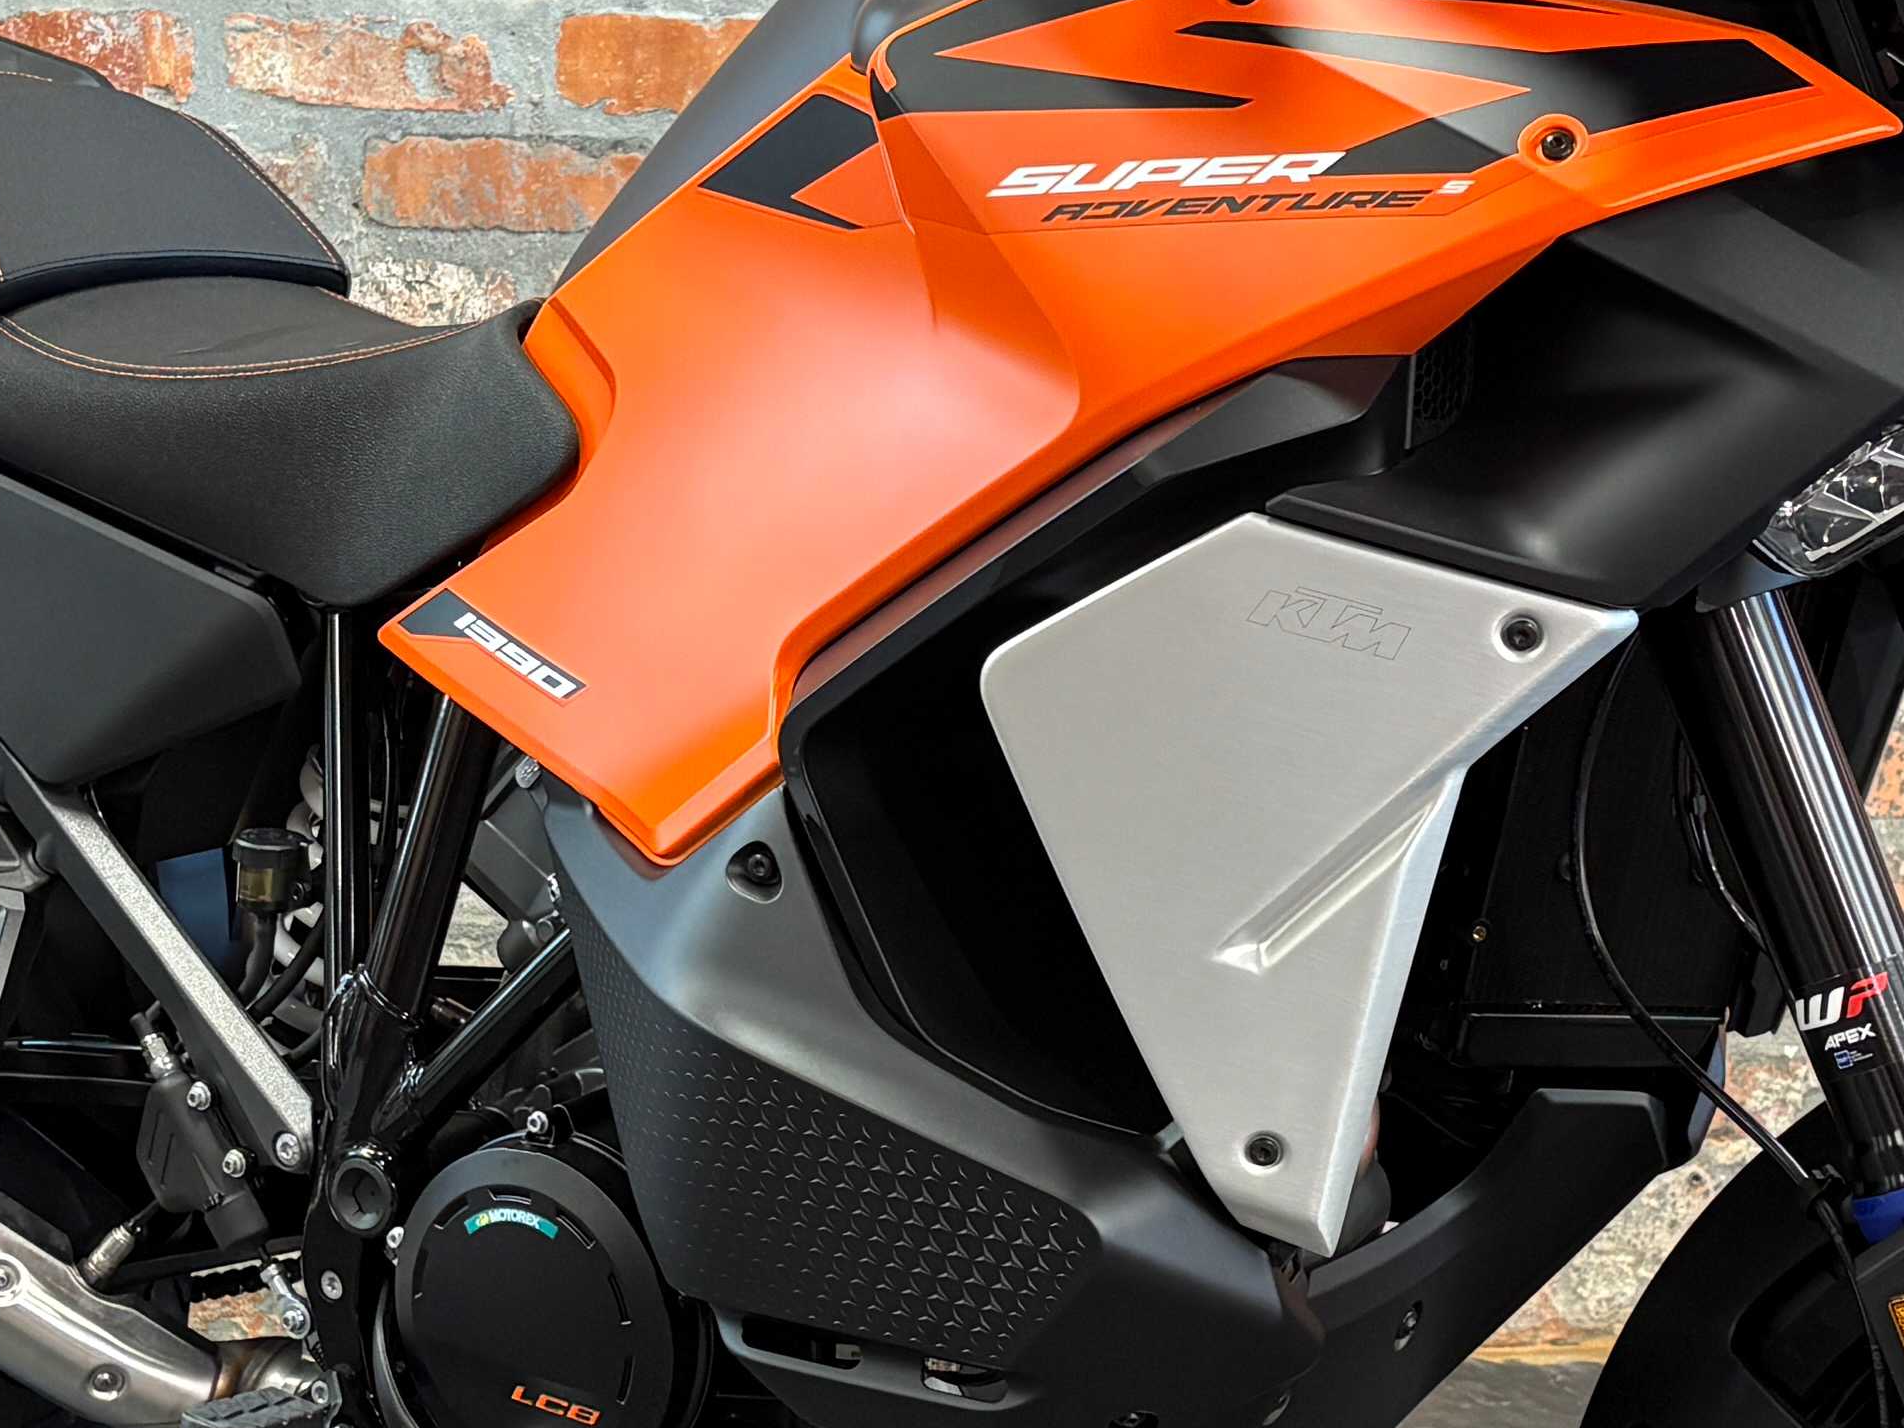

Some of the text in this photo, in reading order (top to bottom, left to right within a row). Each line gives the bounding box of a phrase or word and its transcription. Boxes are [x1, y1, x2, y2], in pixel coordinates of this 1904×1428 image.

[985, 151, 1347, 198] SUPER
[1041, 179, 1476, 223] ADVENTURE S
[1245, 585, 1412, 661] KTM
[453, 610, 582, 700] 1390
[1796, 972, 1889, 1031] WP
[1824, 1023, 1876, 1051] APEX
[488, 1207, 541, 1230] MOTOREX
[510, 1384, 601, 1427] LC8
